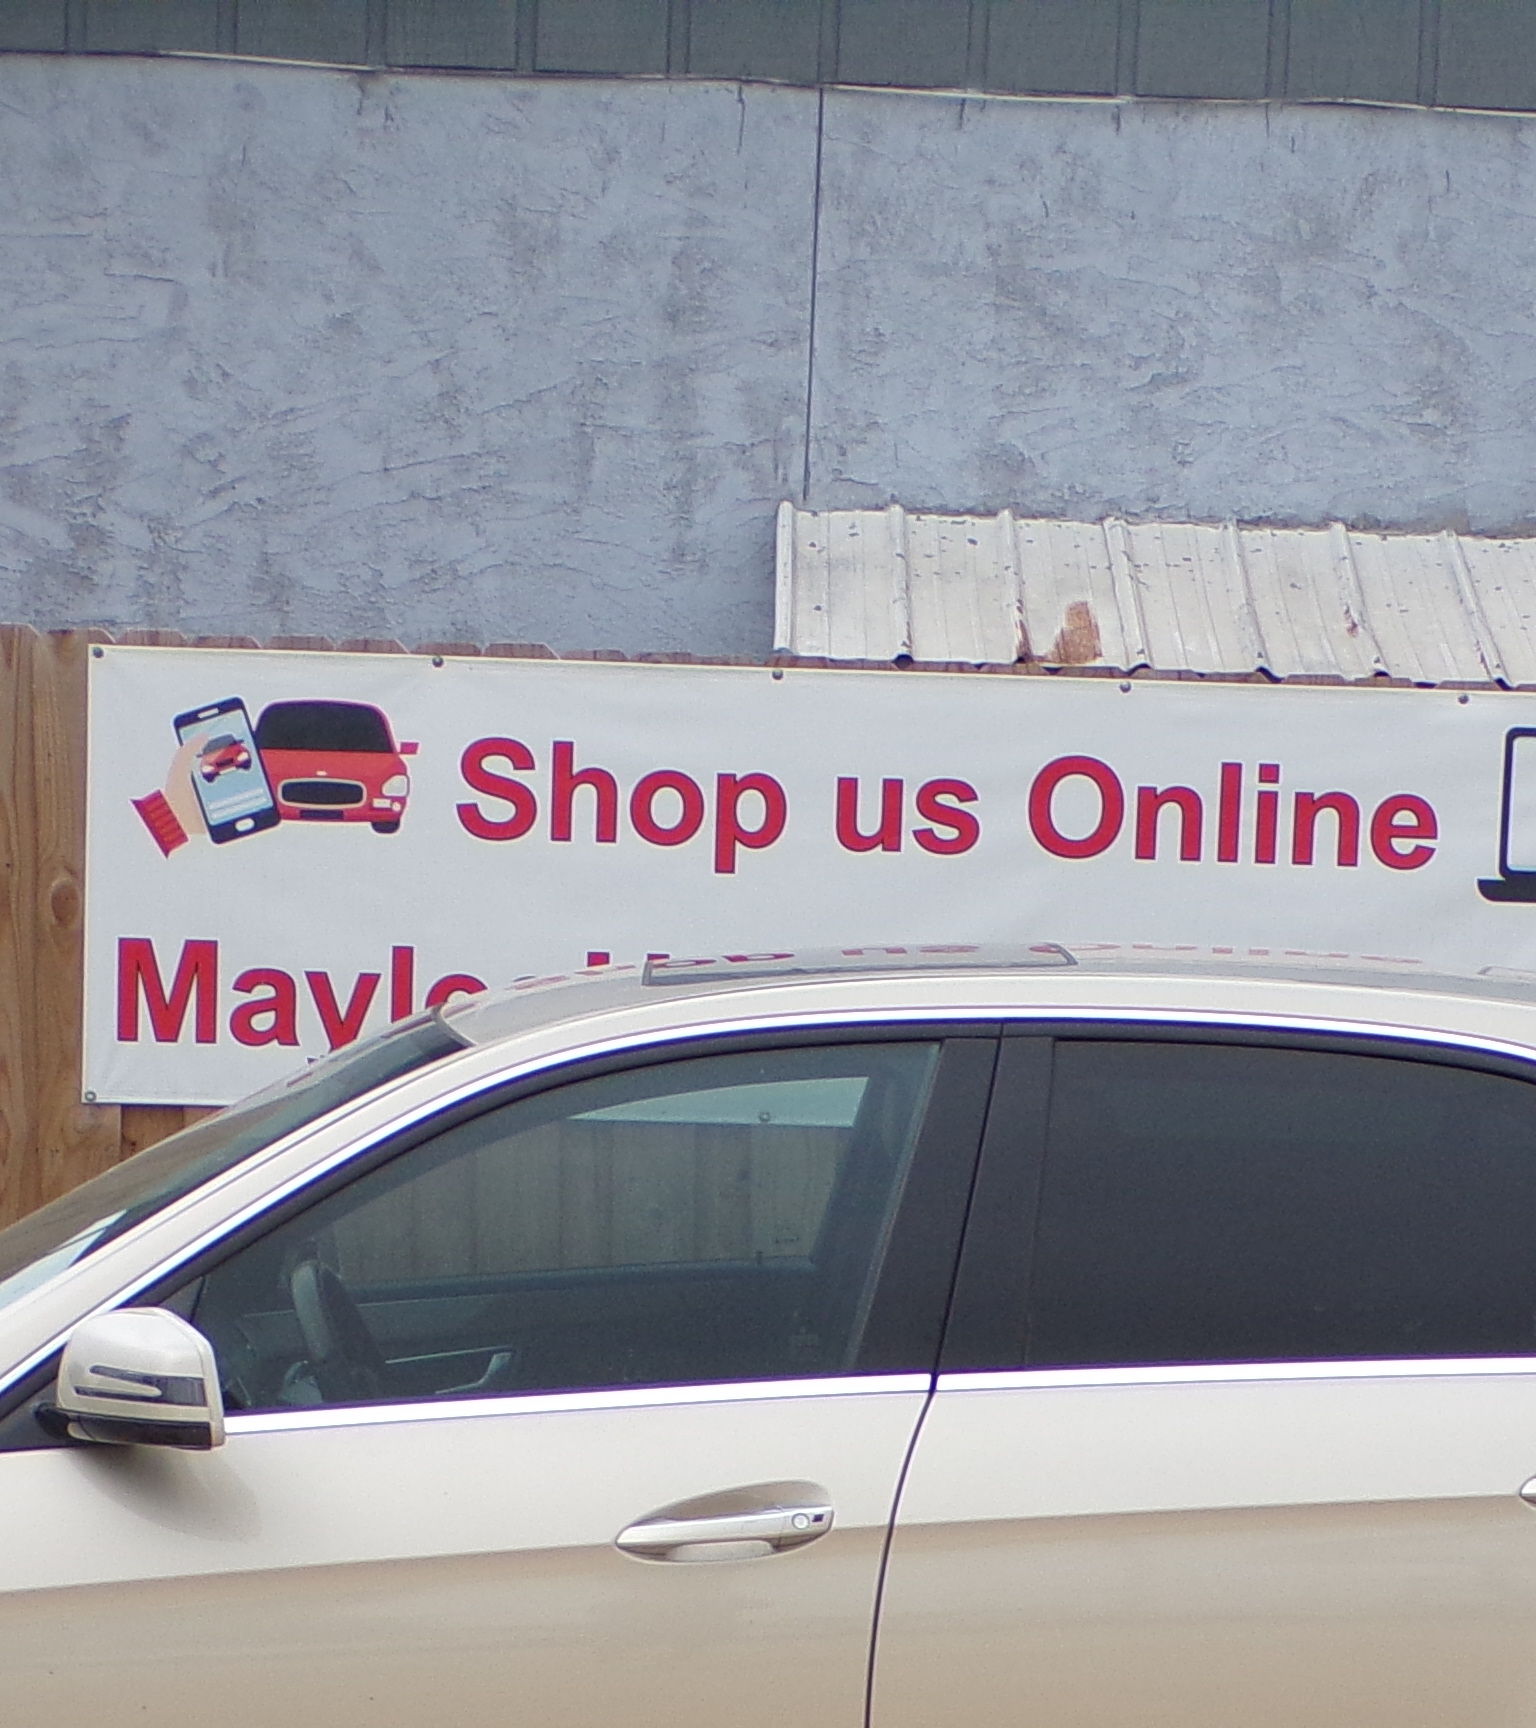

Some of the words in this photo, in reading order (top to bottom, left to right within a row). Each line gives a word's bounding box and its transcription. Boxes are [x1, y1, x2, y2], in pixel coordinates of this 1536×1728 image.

[457, 736, 787, 874] Shop
[836, 776, 981, 856] us
[1027, 754, 1439, 871] Online
